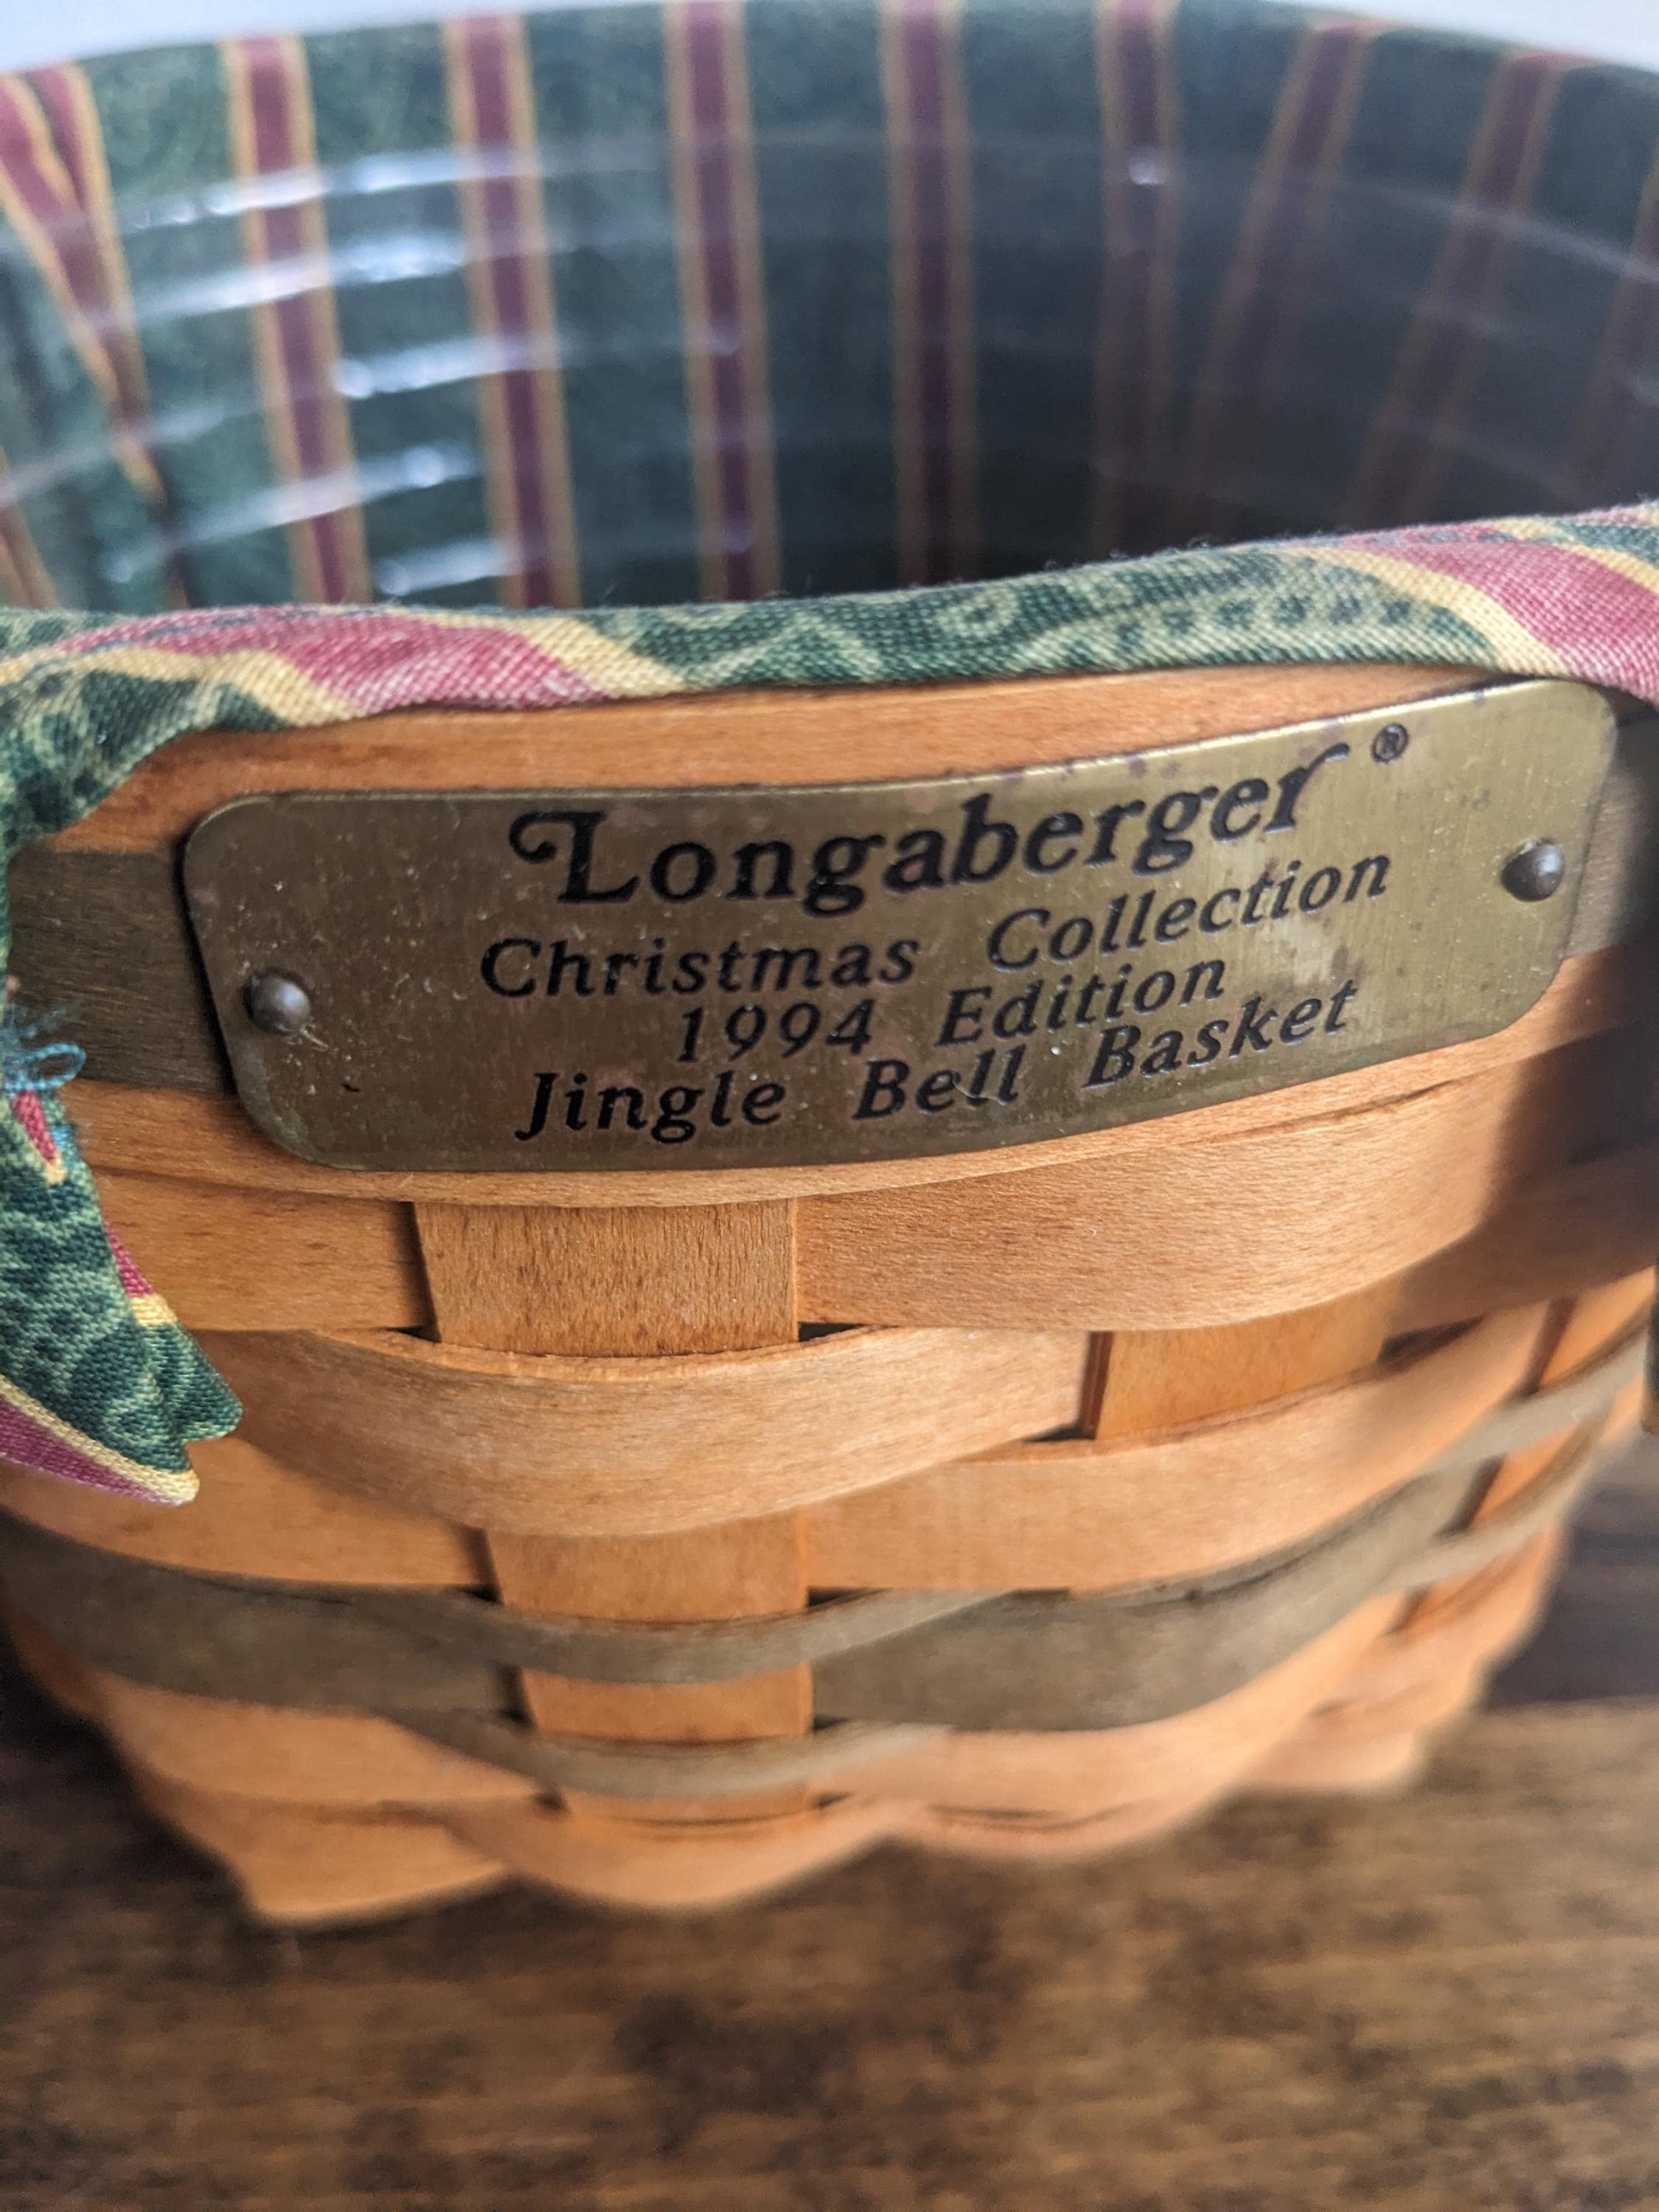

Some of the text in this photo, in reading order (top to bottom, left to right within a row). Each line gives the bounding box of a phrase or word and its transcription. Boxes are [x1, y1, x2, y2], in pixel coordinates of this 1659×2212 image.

[508, 742, 1349, 918] Longaberger
[480, 854, 1391, 998] Christmas Collection
[515, 978, 1359, 1144] Jingle Bell Basket
[677, 959, 1225, 1062] 1994 Edition
